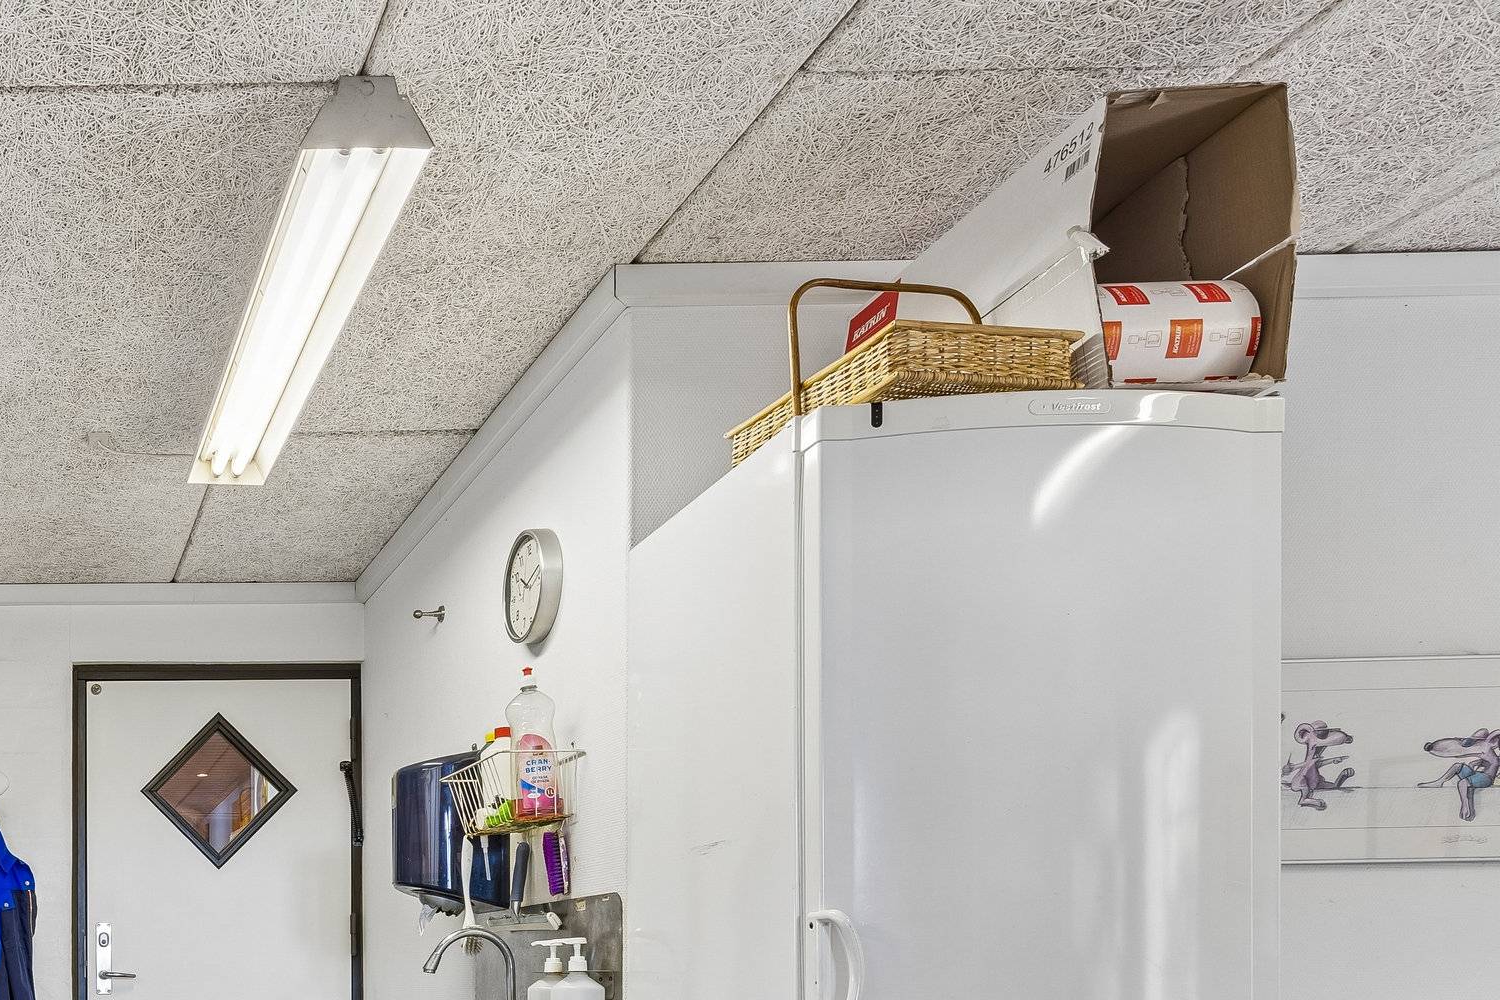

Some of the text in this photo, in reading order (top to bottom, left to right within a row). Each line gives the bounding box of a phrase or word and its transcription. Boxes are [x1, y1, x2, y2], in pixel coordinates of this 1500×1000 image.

[1043, 121, 1094, 173] 476512
[851, 303, 890, 343] KATRIN
[1051, 402, 1101, 411] Vestfrost
